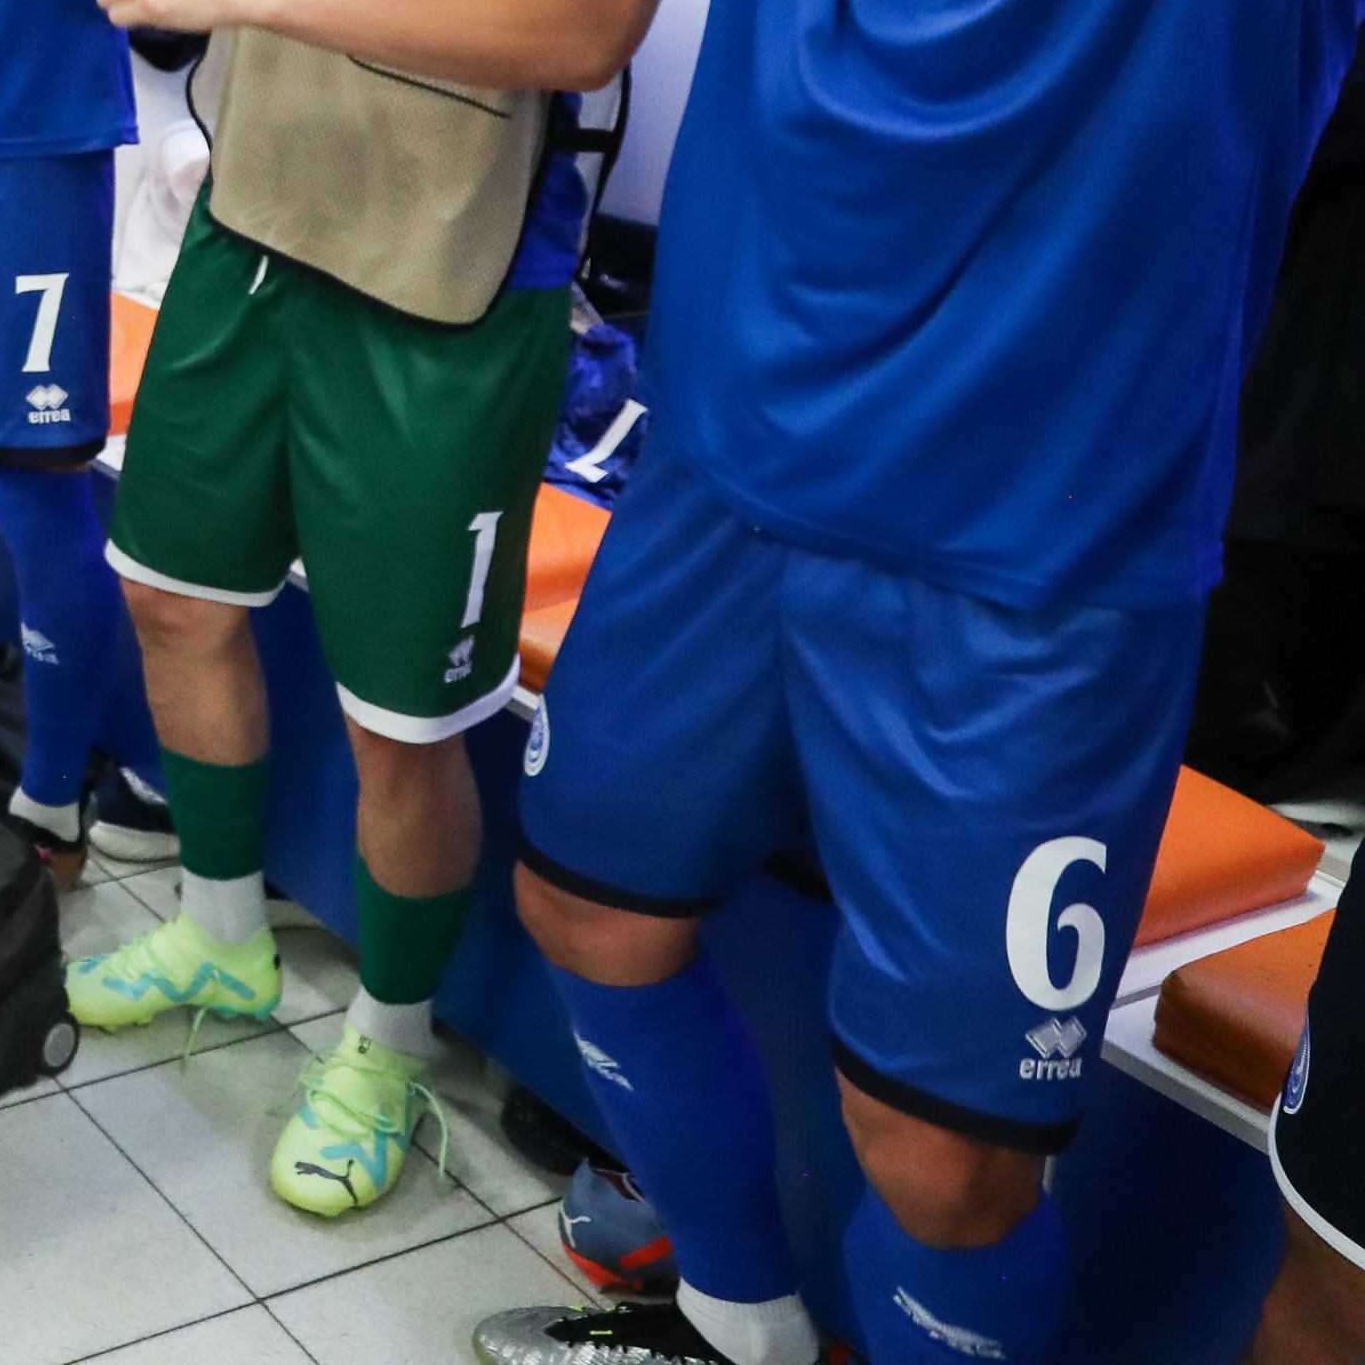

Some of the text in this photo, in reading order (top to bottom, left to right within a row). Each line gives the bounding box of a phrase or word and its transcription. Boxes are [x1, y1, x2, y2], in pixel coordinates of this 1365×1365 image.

[15, 272, 70, 372] 7
[28, 408, 71, 424] errea
[460, 511, 503, 629] 1
[1006, 836, 1106, 1011] 6
[1019, 1057, 1083, 1080] errea
